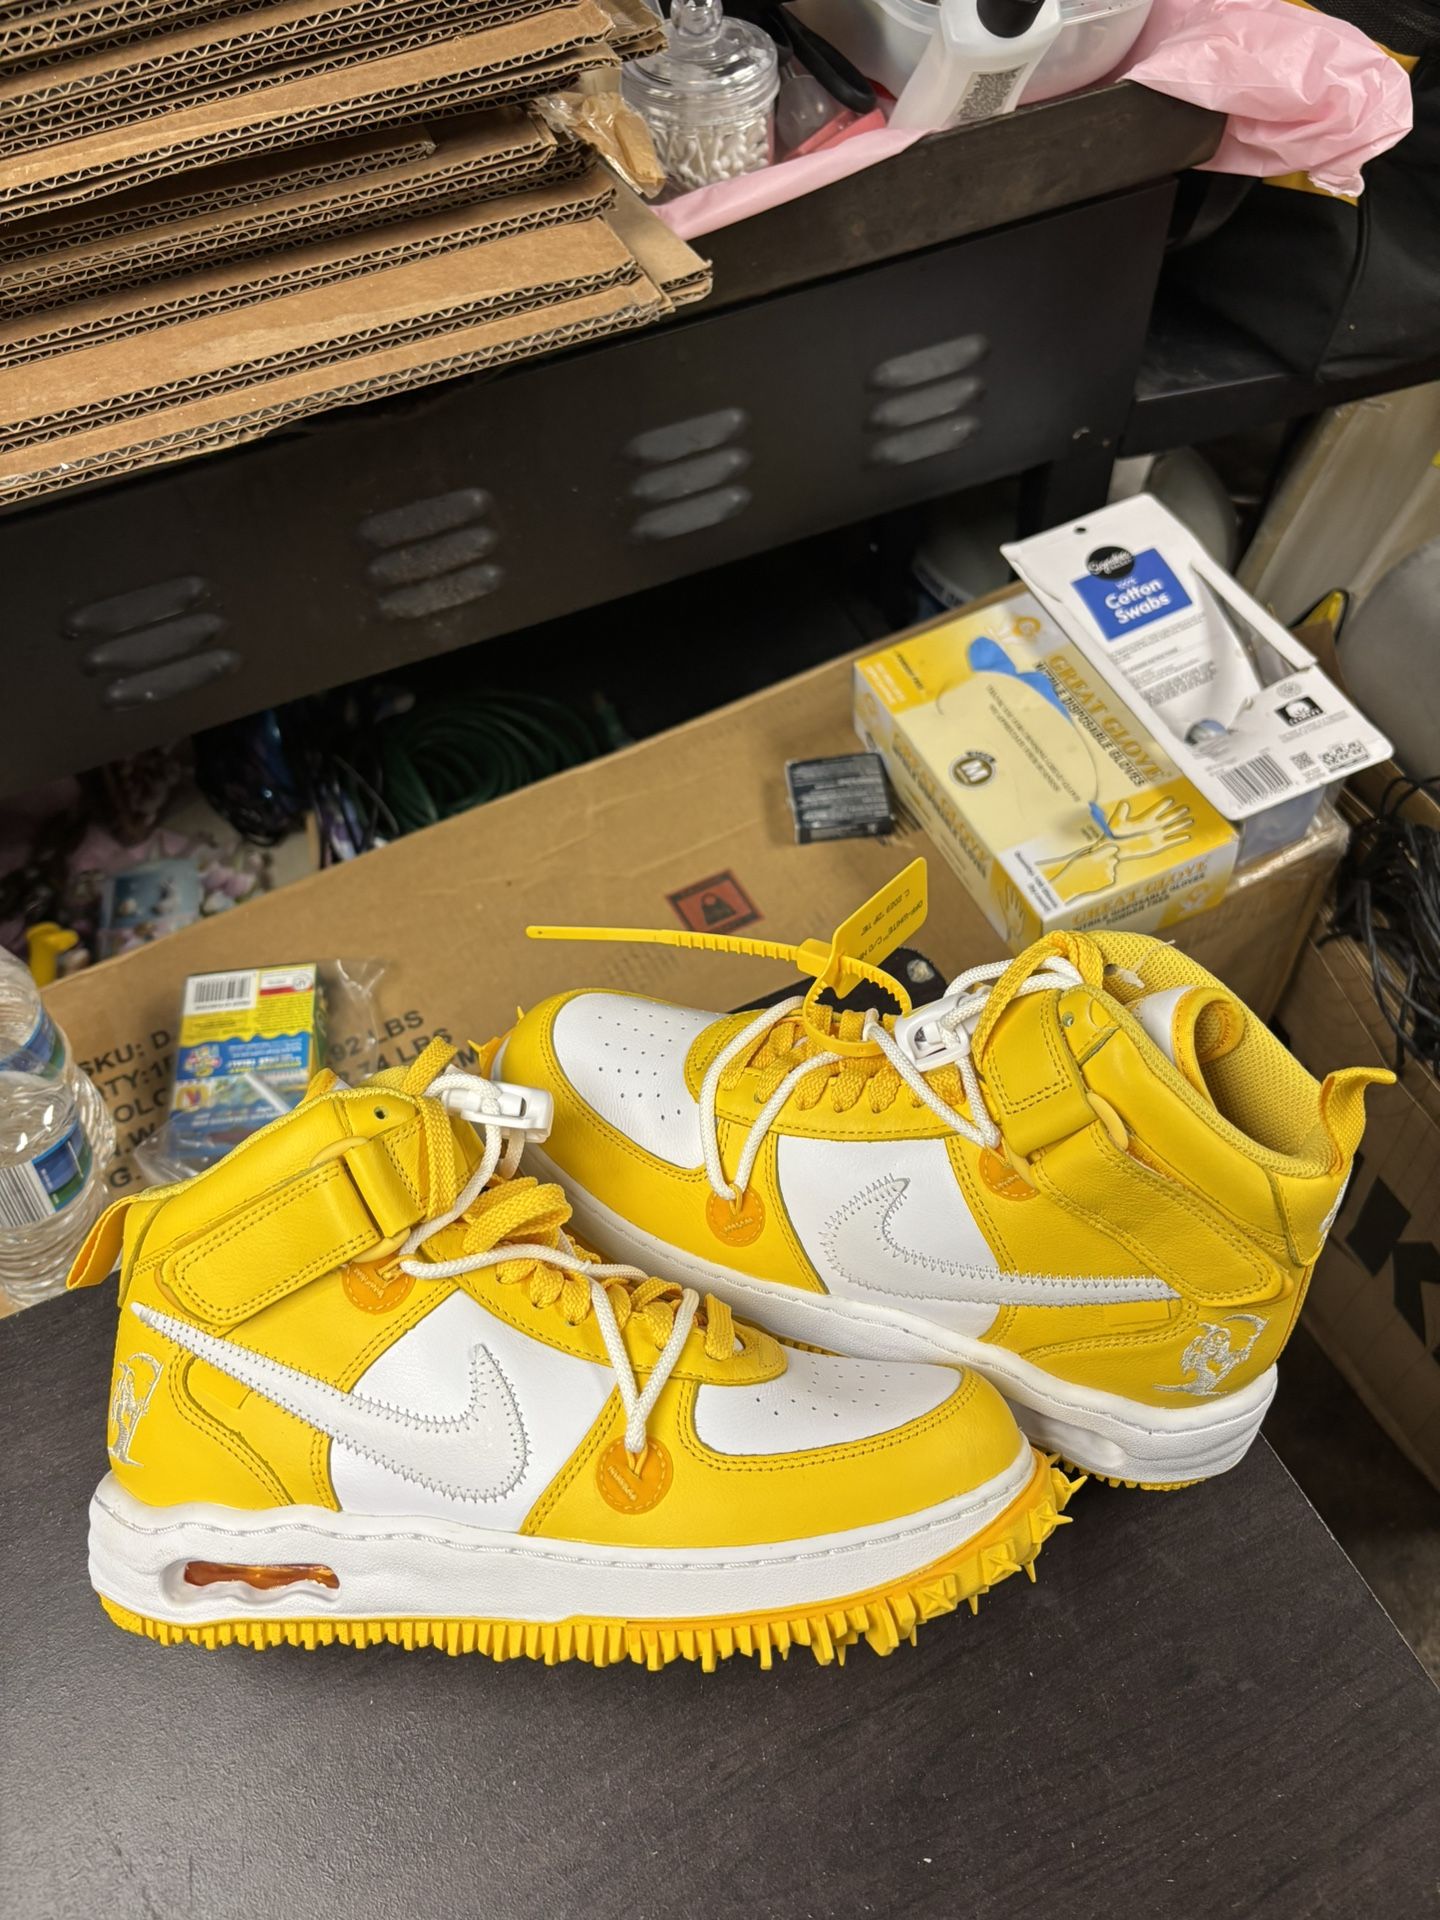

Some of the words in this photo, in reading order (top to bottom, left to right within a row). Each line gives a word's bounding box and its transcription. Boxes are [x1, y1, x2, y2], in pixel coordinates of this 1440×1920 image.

[1105, 578, 1165, 609] Cotton
[1114, 592, 1170, 624] Swabs
[1050, 655, 1108, 715] GREAT
[1104, 716, 1164, 782] GLOVE
[1061, 696, 1113, 751] DISPOSABLE
[1108, 749, 1145, 788] GLOVES
[961, 760, 989, 782] M
